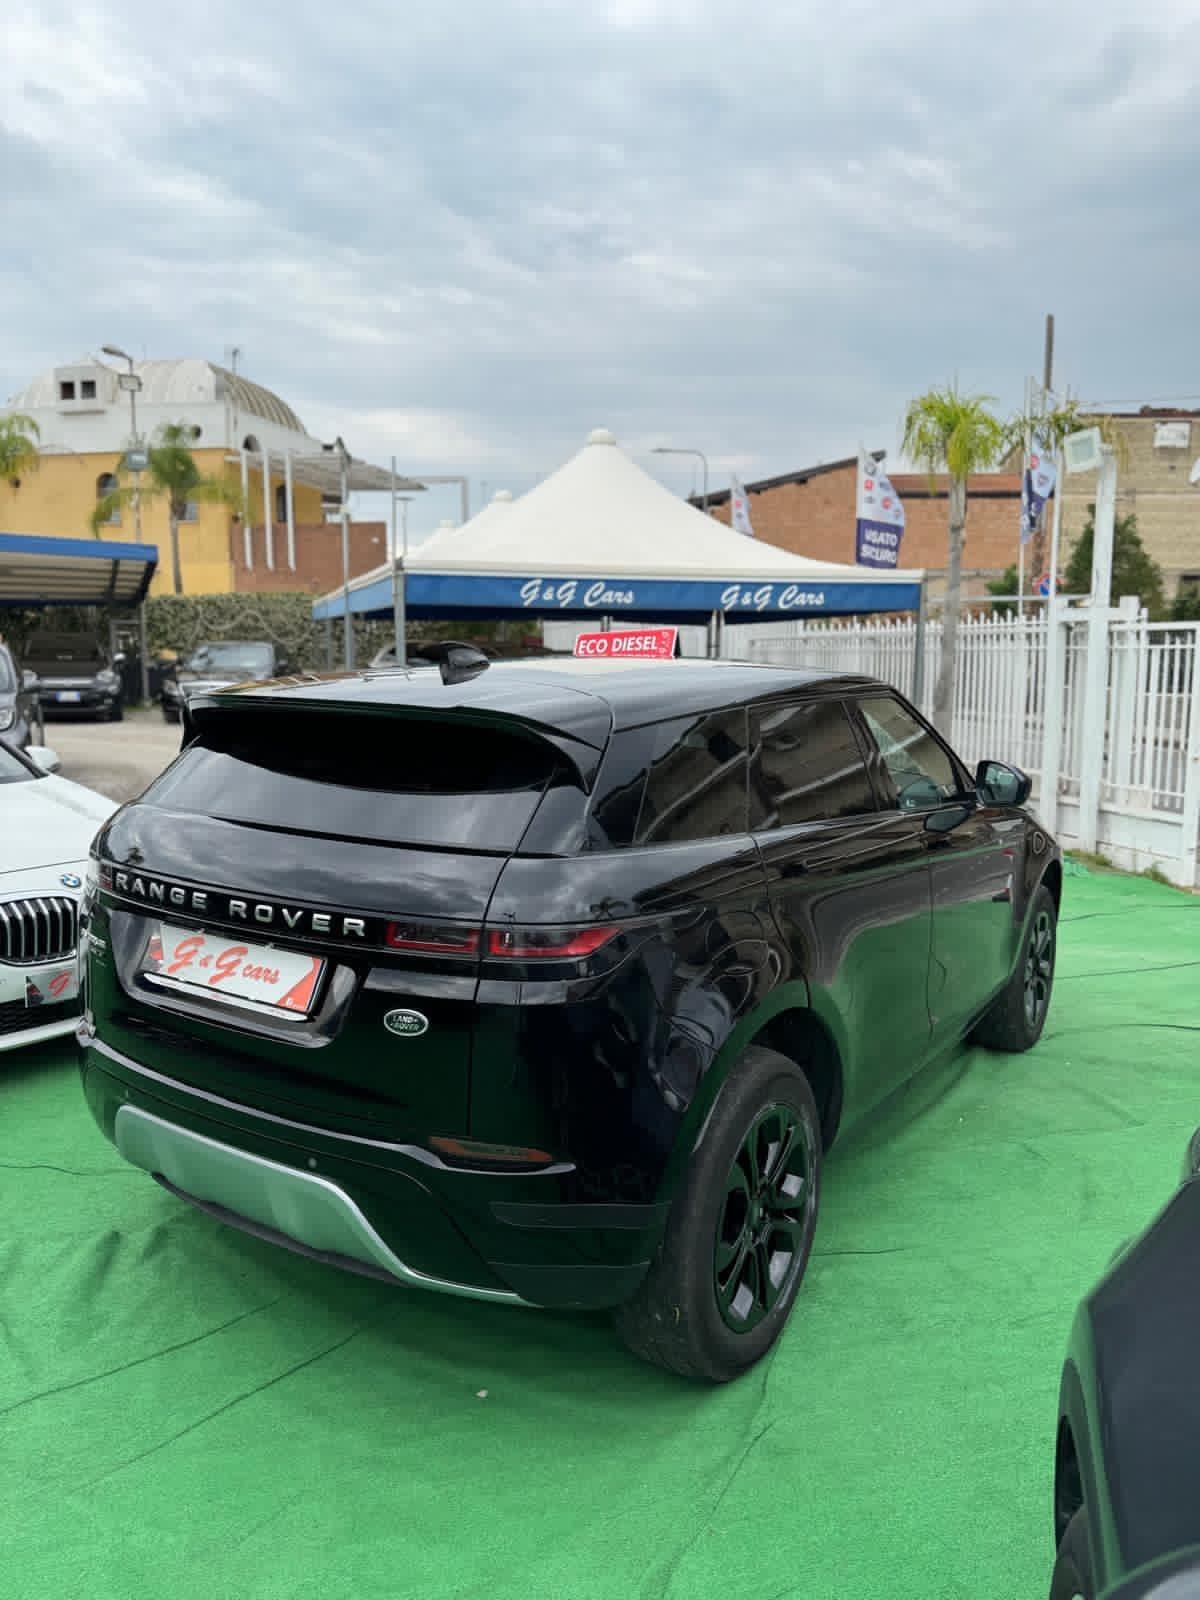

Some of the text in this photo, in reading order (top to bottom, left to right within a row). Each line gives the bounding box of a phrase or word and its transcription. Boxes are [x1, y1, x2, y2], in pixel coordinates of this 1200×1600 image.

[583, 582, 634, 607] Cars
[778, 585, 825, 609] Cars
[578, 635, 657, 654] ECO DIESEL
[115, 872, 366, 937] RANGE ROVER
[242, 962, 281, 984] cars
